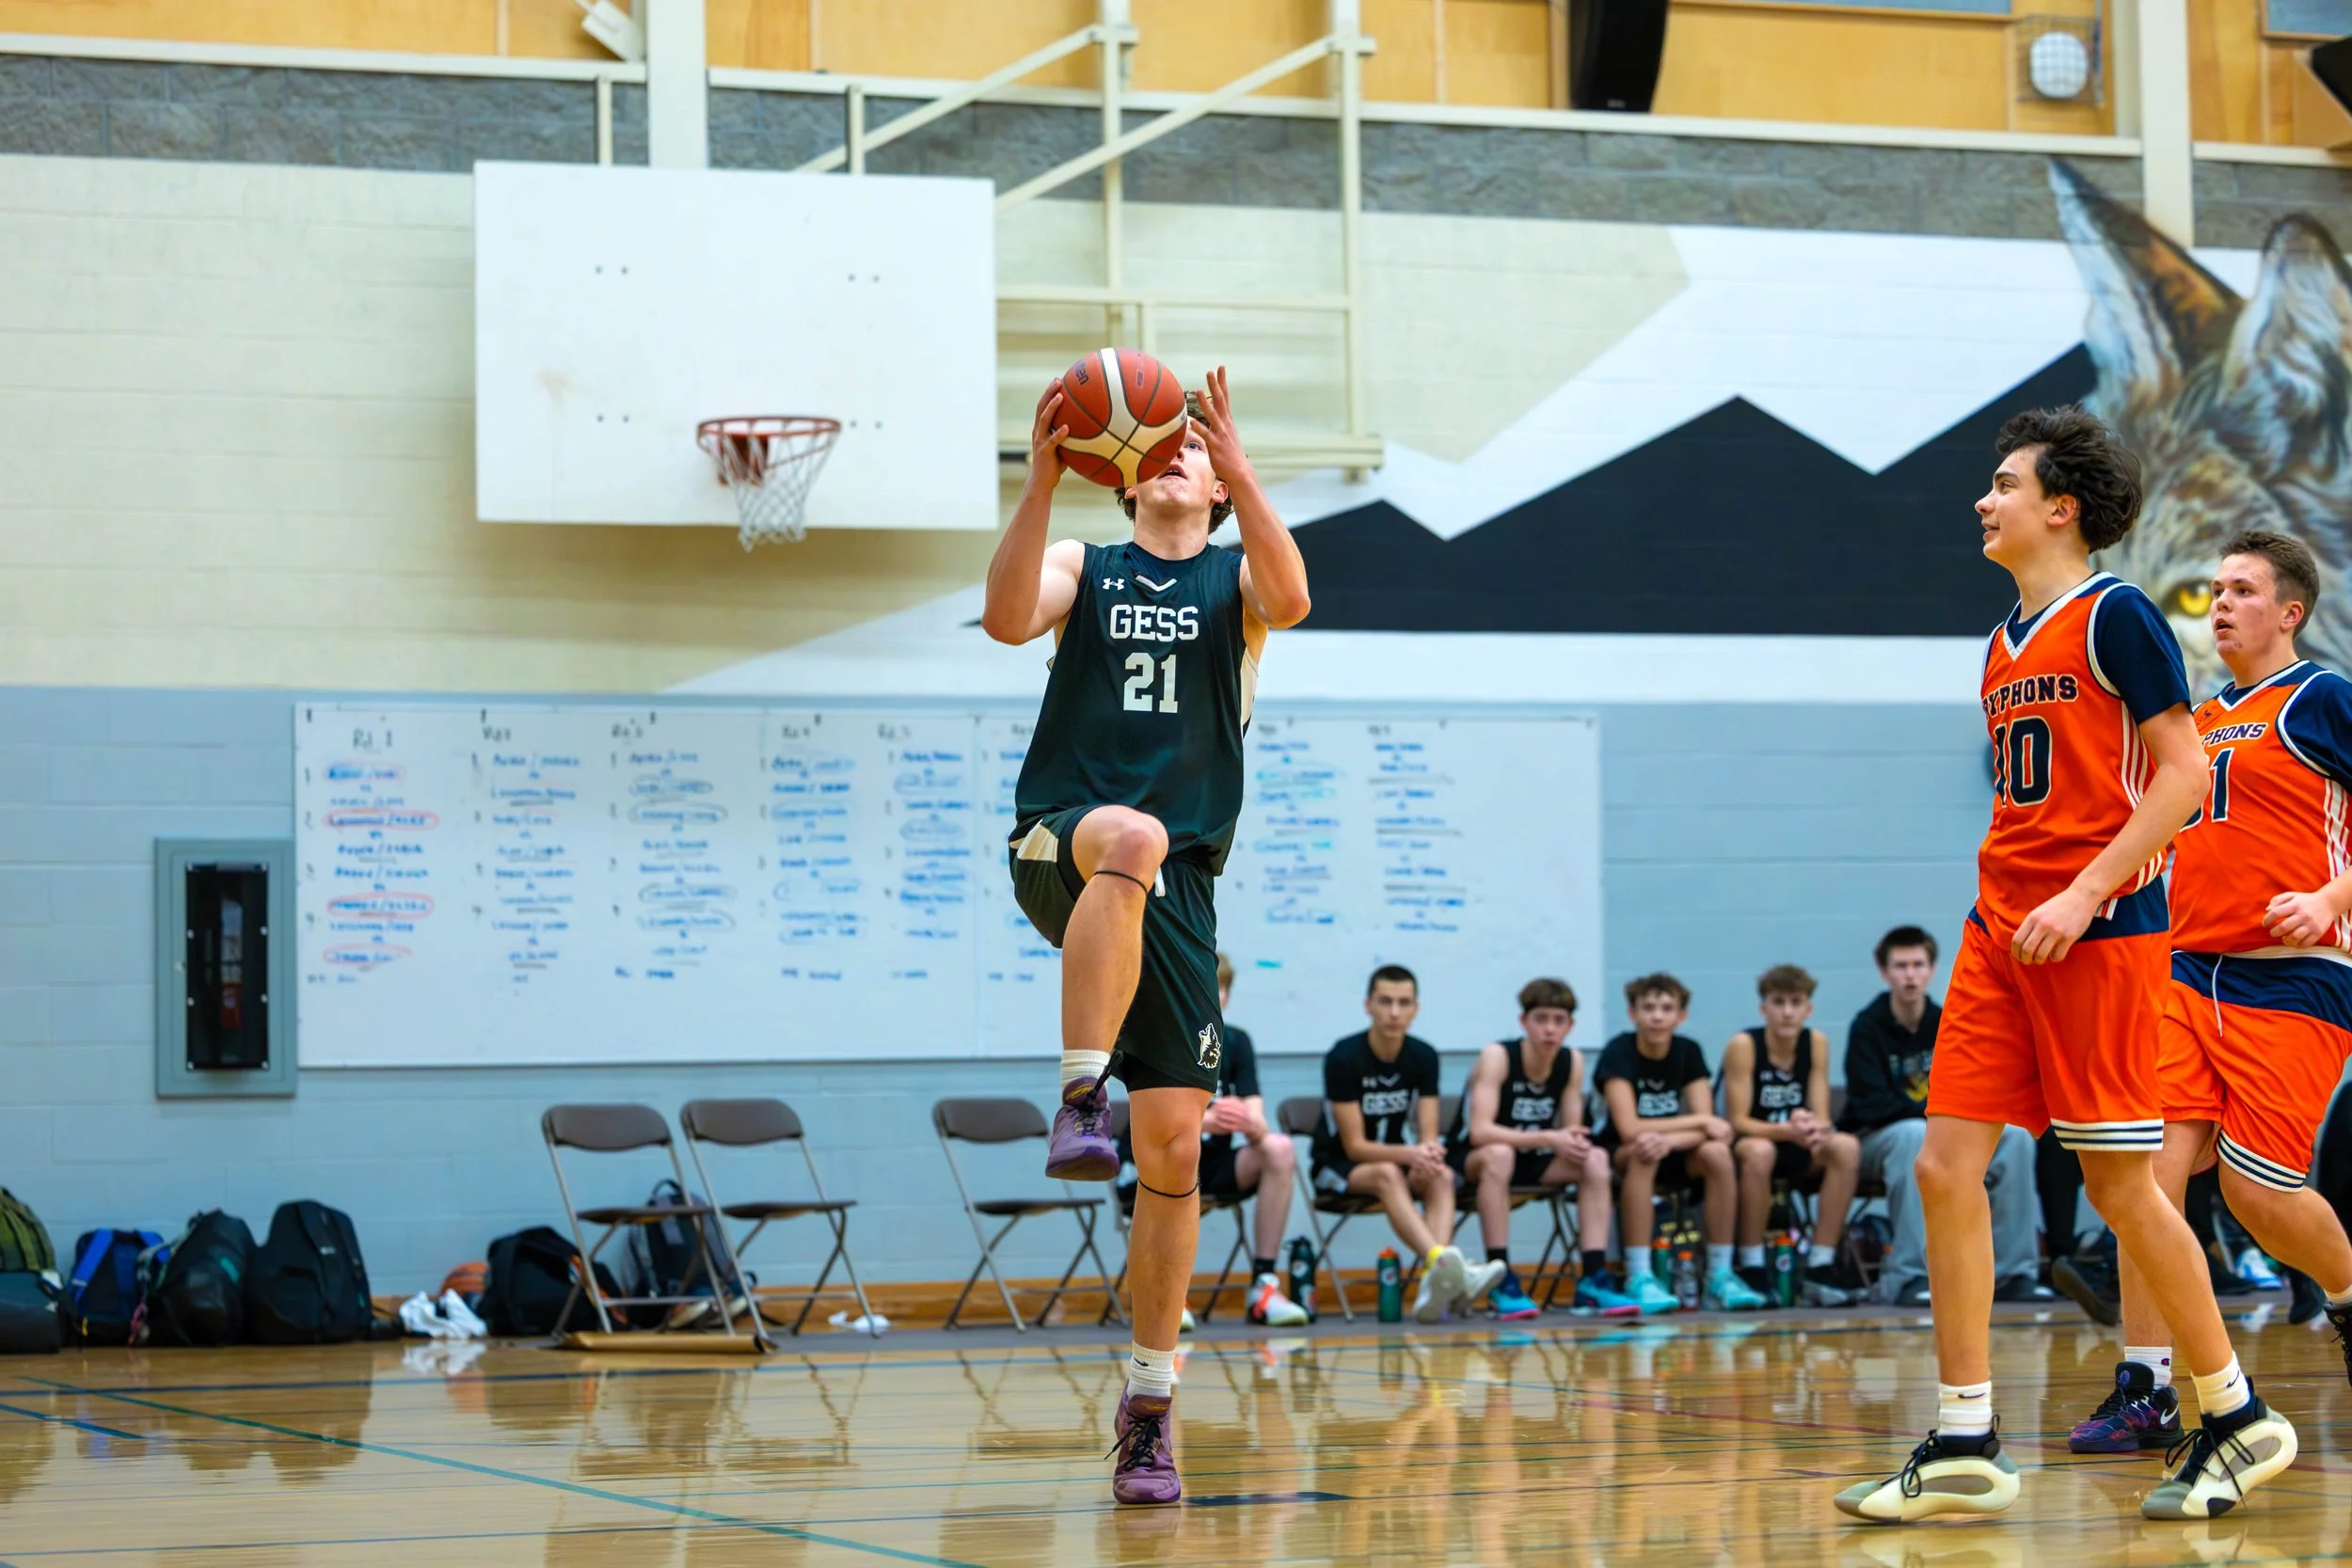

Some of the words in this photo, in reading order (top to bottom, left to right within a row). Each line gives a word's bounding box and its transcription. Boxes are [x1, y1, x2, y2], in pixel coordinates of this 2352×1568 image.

[1109, 604, 1200, 642] GESS
[1123, 652, 1179, 714] 21
[1981, 673, 2079, 721] RYPHONS
[2201, 721, 2269, 748] PHONS
[1994, 715, 2053, 809] 10
[1362, 1089, 1409, 1116] GESS
